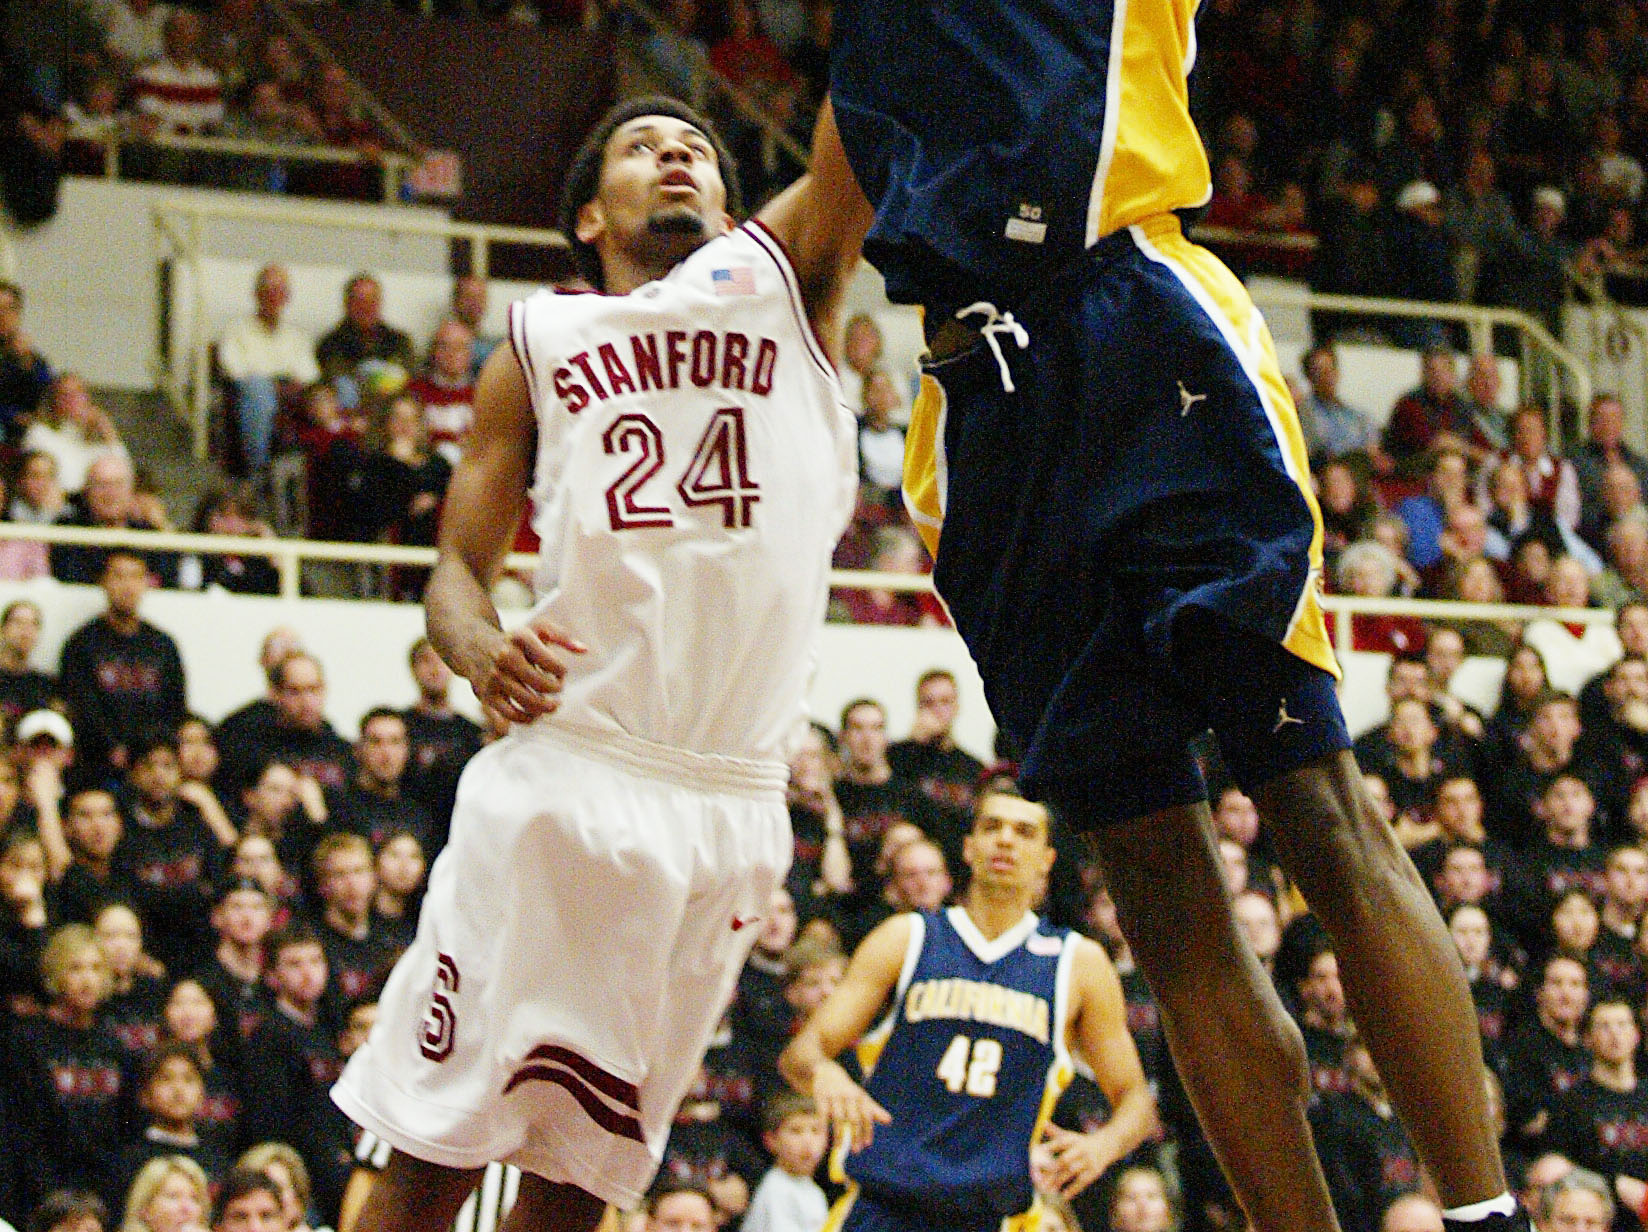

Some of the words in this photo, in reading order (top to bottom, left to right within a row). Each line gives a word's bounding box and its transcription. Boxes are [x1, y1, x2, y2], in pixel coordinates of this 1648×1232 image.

[553, 330, 778, 414] STANFORD
[602, 407, 760, 531] 24
[936, 1034, 1003, 1098] 42
